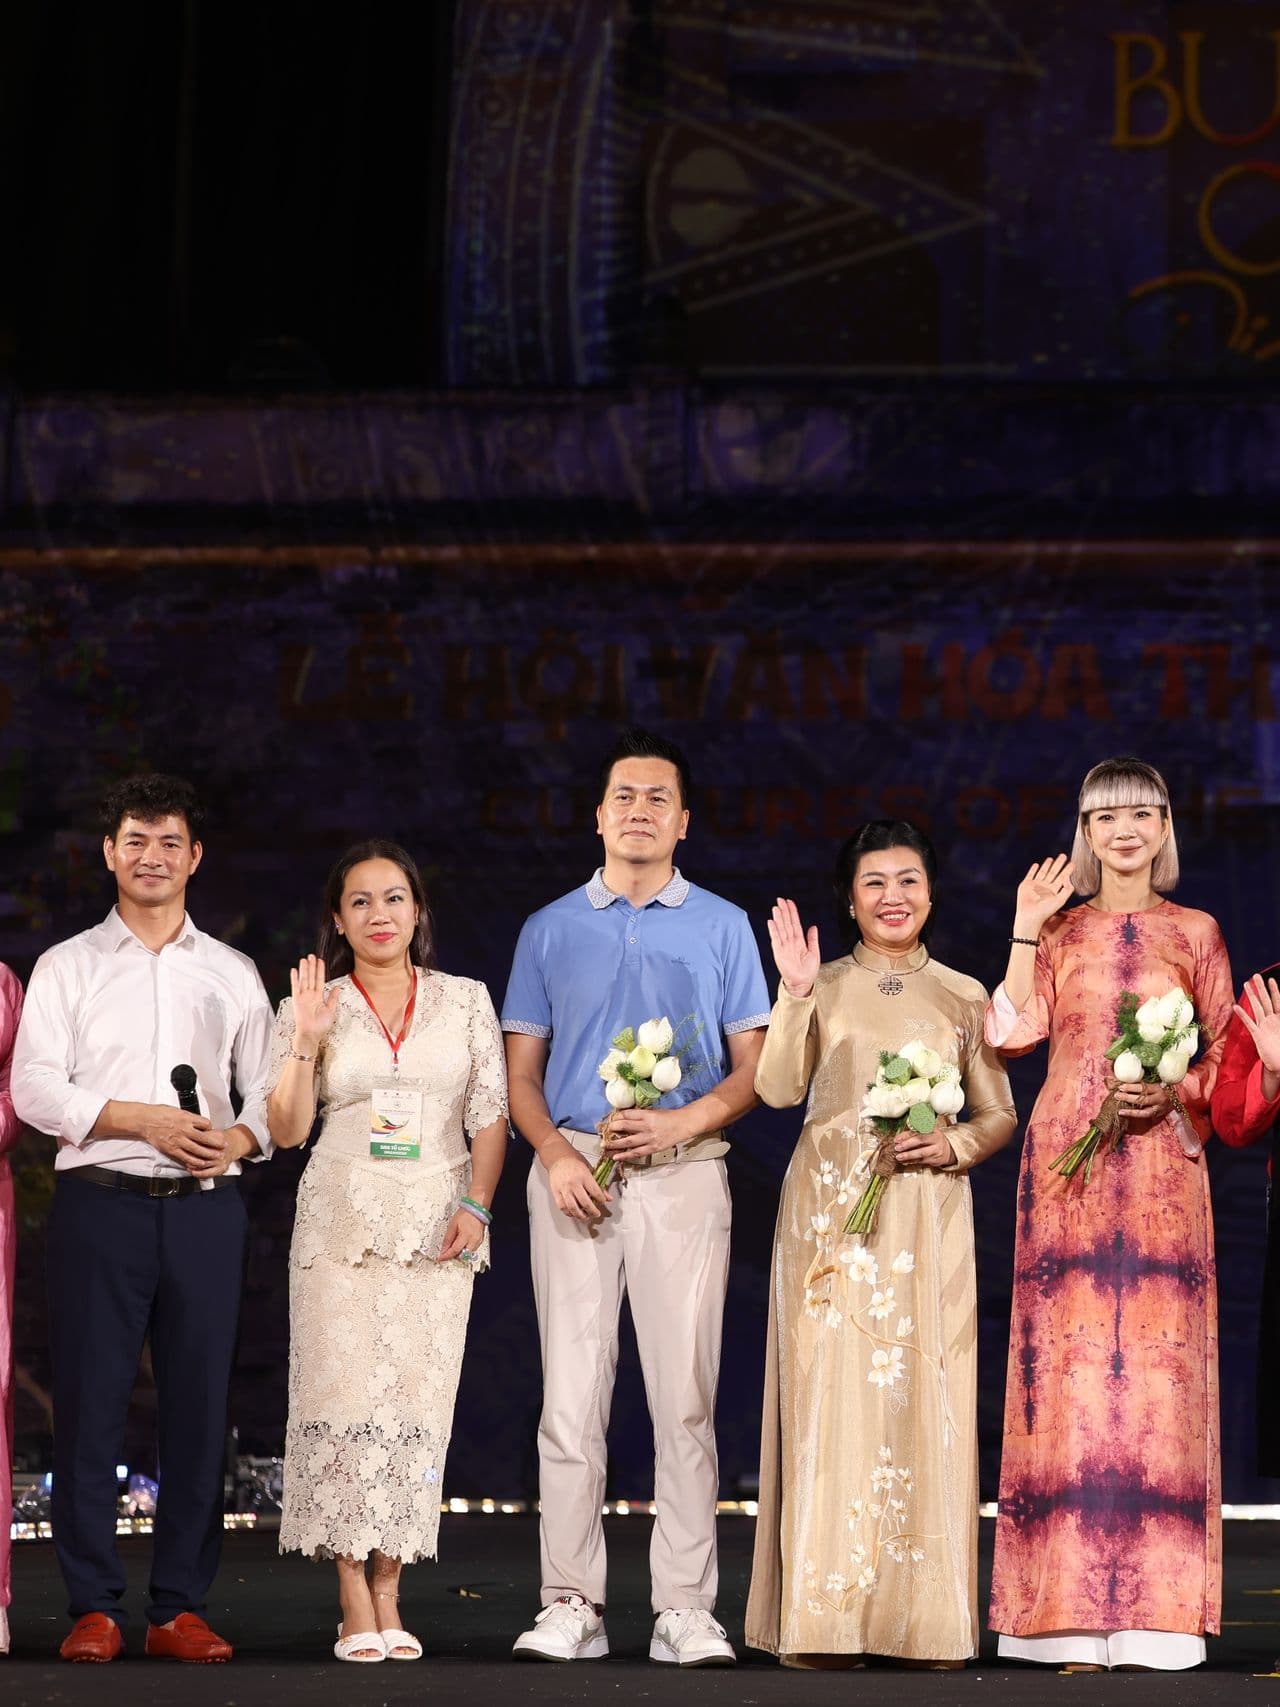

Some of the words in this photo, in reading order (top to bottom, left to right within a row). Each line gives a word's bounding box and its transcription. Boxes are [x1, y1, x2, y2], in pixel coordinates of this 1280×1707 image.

[440, 626, 626, 740] HỘI
[901, 626, 1114, 721] HÓA
[479, 785, 932, 838] CUURES
[957, 785, 1068, 838] OF
